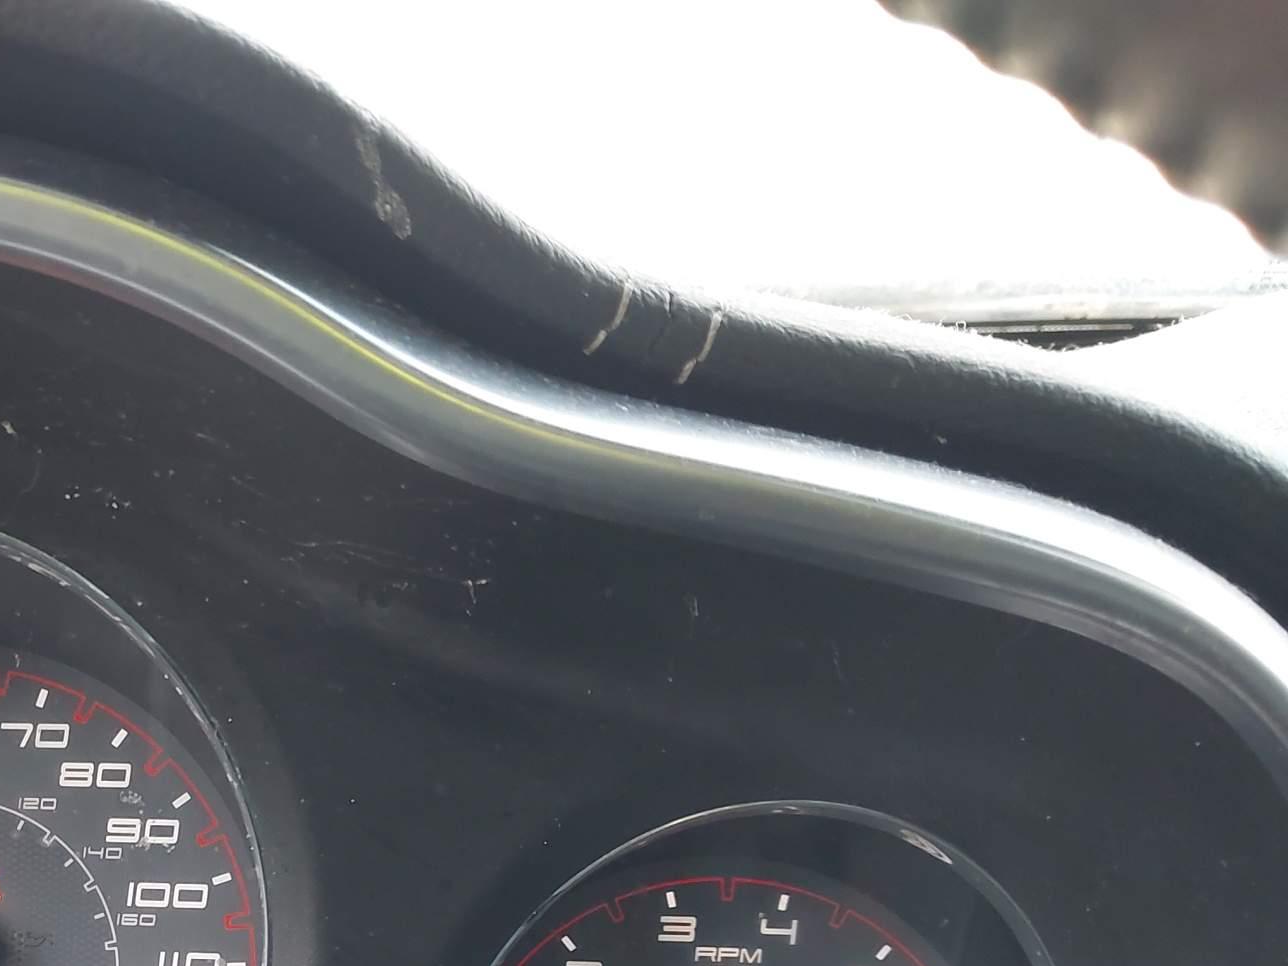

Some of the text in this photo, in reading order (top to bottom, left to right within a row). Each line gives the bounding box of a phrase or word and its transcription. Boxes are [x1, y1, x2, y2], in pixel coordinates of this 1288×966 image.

[1, 723, 69, 749] 70
[59, 763, 131, 788] 80
[18, 797, 57, 811] 120
[106, 818, 179, 844] 90
[83, 847, 122, 860] 140
[127, 882, 208, 909] 100
[116, 913, 156, 926] 160
[658, 916, 696, 942] 3
[760, 919, 798, 945] 4
[695, 947, 762, 963] RPM
